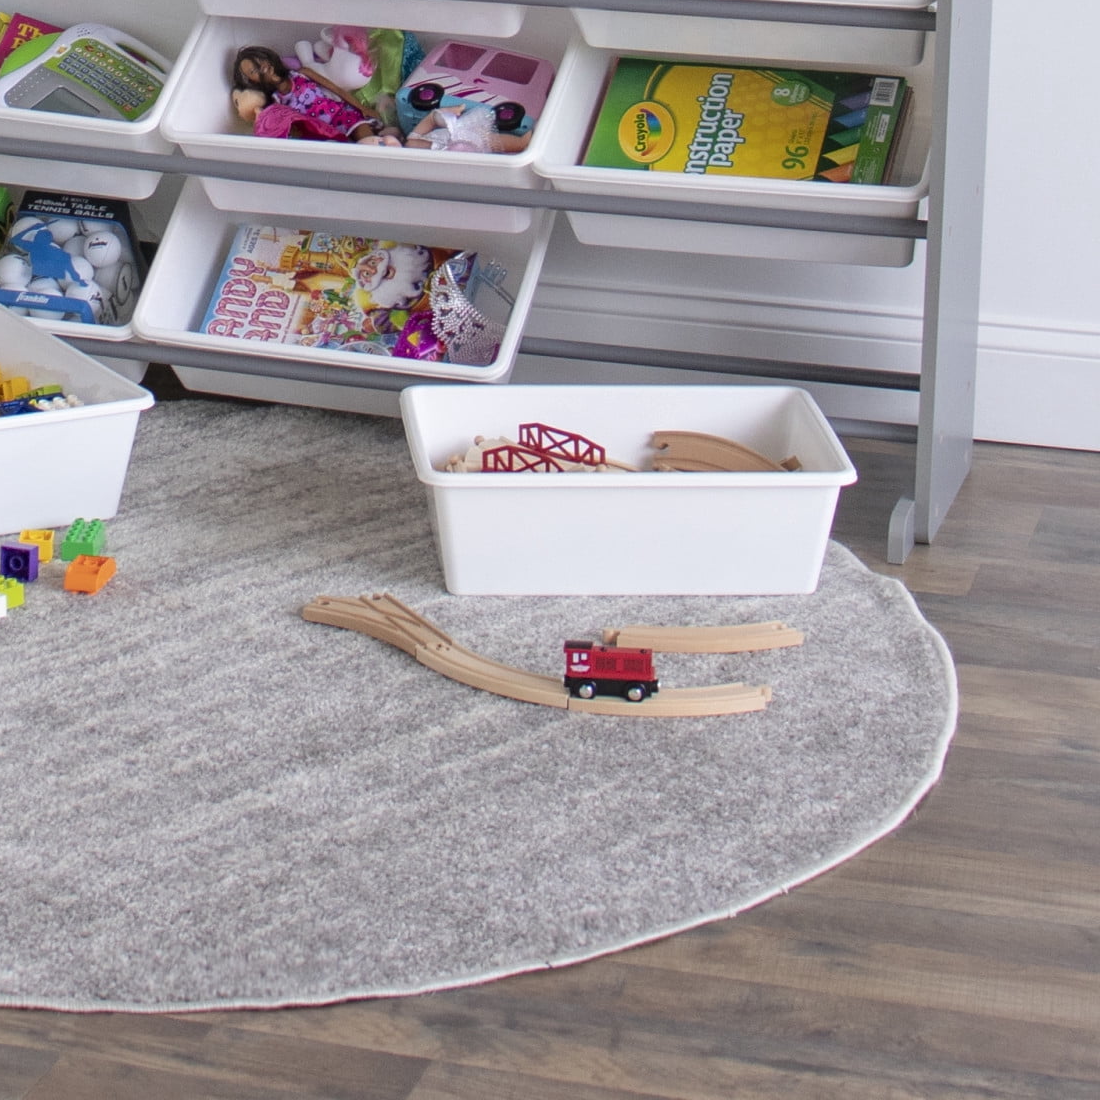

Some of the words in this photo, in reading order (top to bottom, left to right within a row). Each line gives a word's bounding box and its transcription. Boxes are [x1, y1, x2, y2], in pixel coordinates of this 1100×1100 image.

[773, 87, 791, 97] 8
[634, 112, 648, 152] Crayola
[708, 108, 745, 167] paper
[781, 145, 809, 169] 96
[27, 204, 71, 214] TENNIS
[74, 209, 115, 219] BALLS
[71, 202, 108, 211] TABLE
